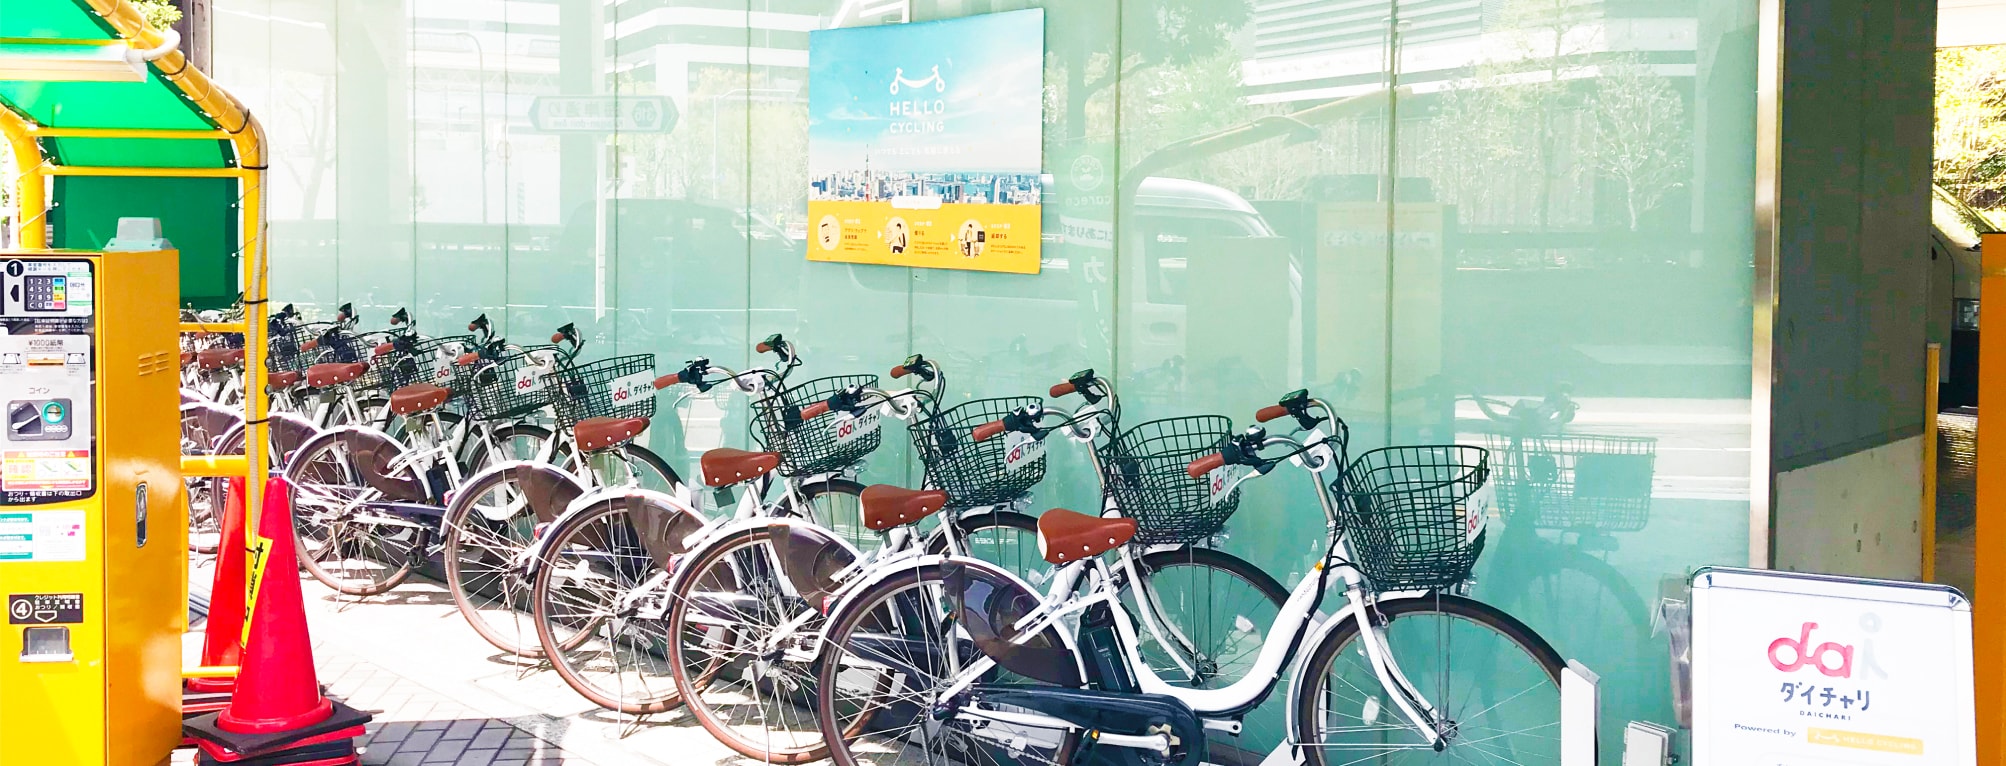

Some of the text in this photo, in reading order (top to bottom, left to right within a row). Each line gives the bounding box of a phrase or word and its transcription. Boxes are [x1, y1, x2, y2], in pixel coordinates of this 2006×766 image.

[889, 99, 945, 117] HELLO
[889, 121, 945, 135] CYCLING
[10, 262, 18, 276] 1
[613, 380, 632, 401] dai
[15, 602, 28, 616] 4
[1779, 681, 1871, 711] ダイチャリ
[1799, 710, 1852, 721] DAICHARI
[1733, 723, 1781, 735] Powered
[1783, 728, 1797, 738] by
